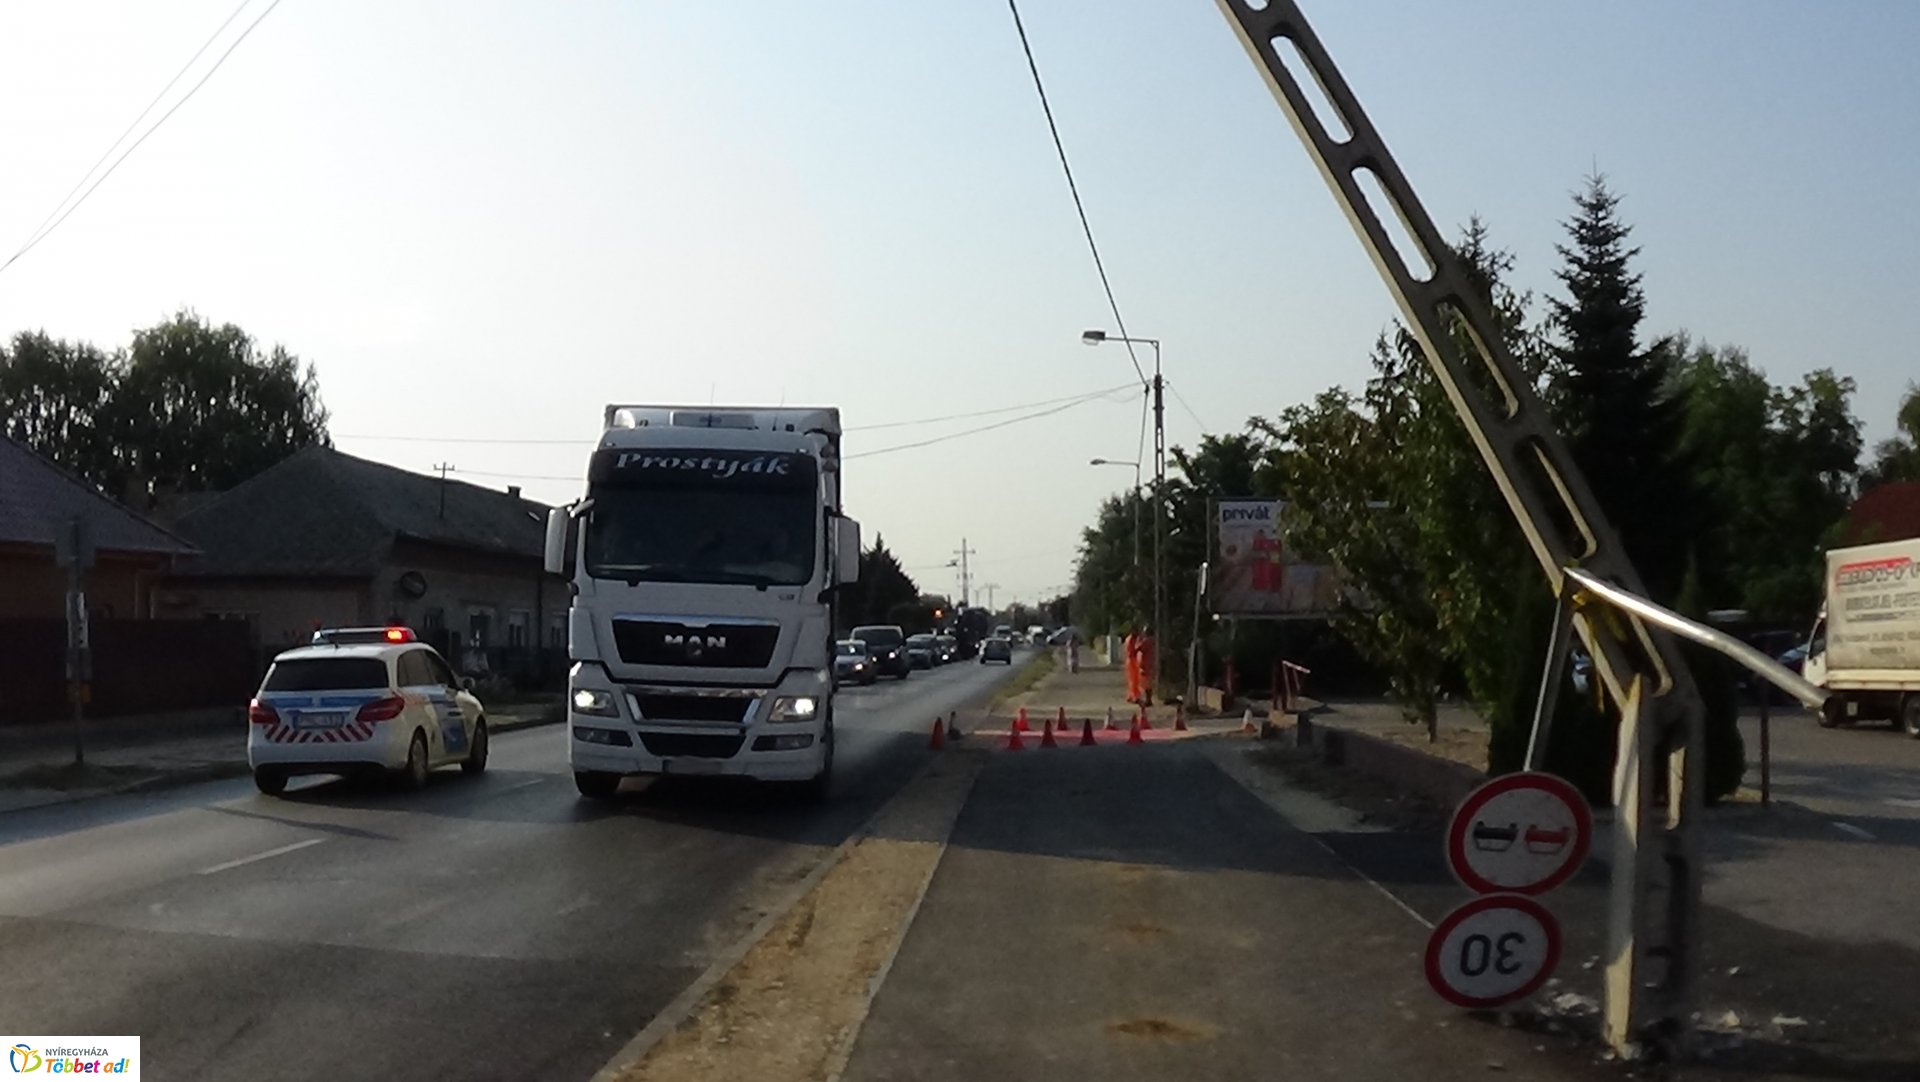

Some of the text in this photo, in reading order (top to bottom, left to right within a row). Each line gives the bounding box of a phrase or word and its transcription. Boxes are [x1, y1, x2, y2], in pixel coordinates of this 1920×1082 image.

[614, 452, 789, 479] Prostyák
[1222, 505, 1271, 522] privát
[664, 634, 726, 648] MAN
[1460, 931, 1527, 977] 30
